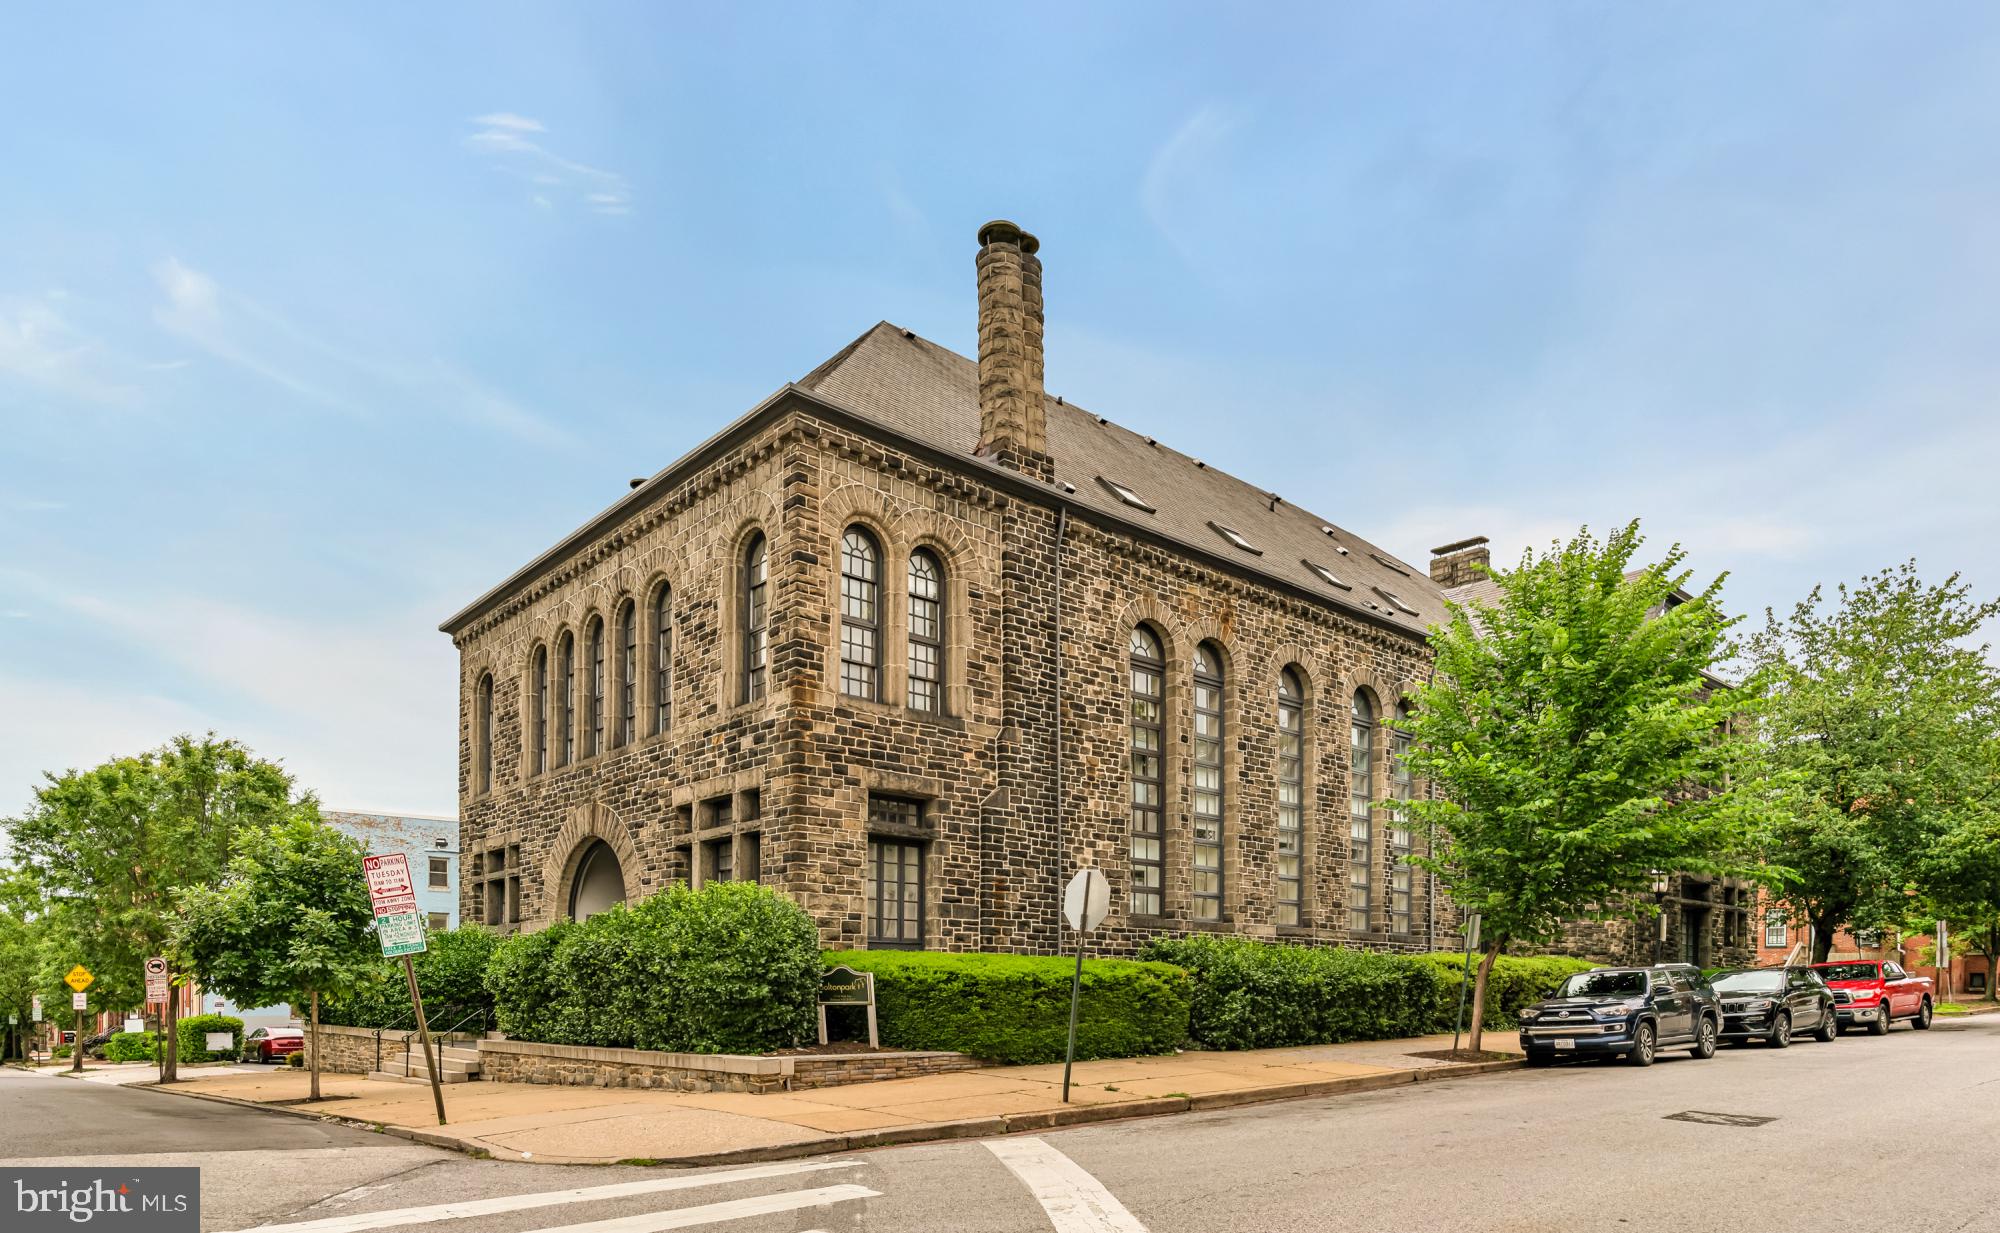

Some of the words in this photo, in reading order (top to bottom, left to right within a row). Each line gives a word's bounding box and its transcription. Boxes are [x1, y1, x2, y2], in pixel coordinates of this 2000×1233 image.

[366, 859, 380, 870] NO
[381, 857, 404, 866] PARKING
[371, 869, 404, 878] TUESDAY
